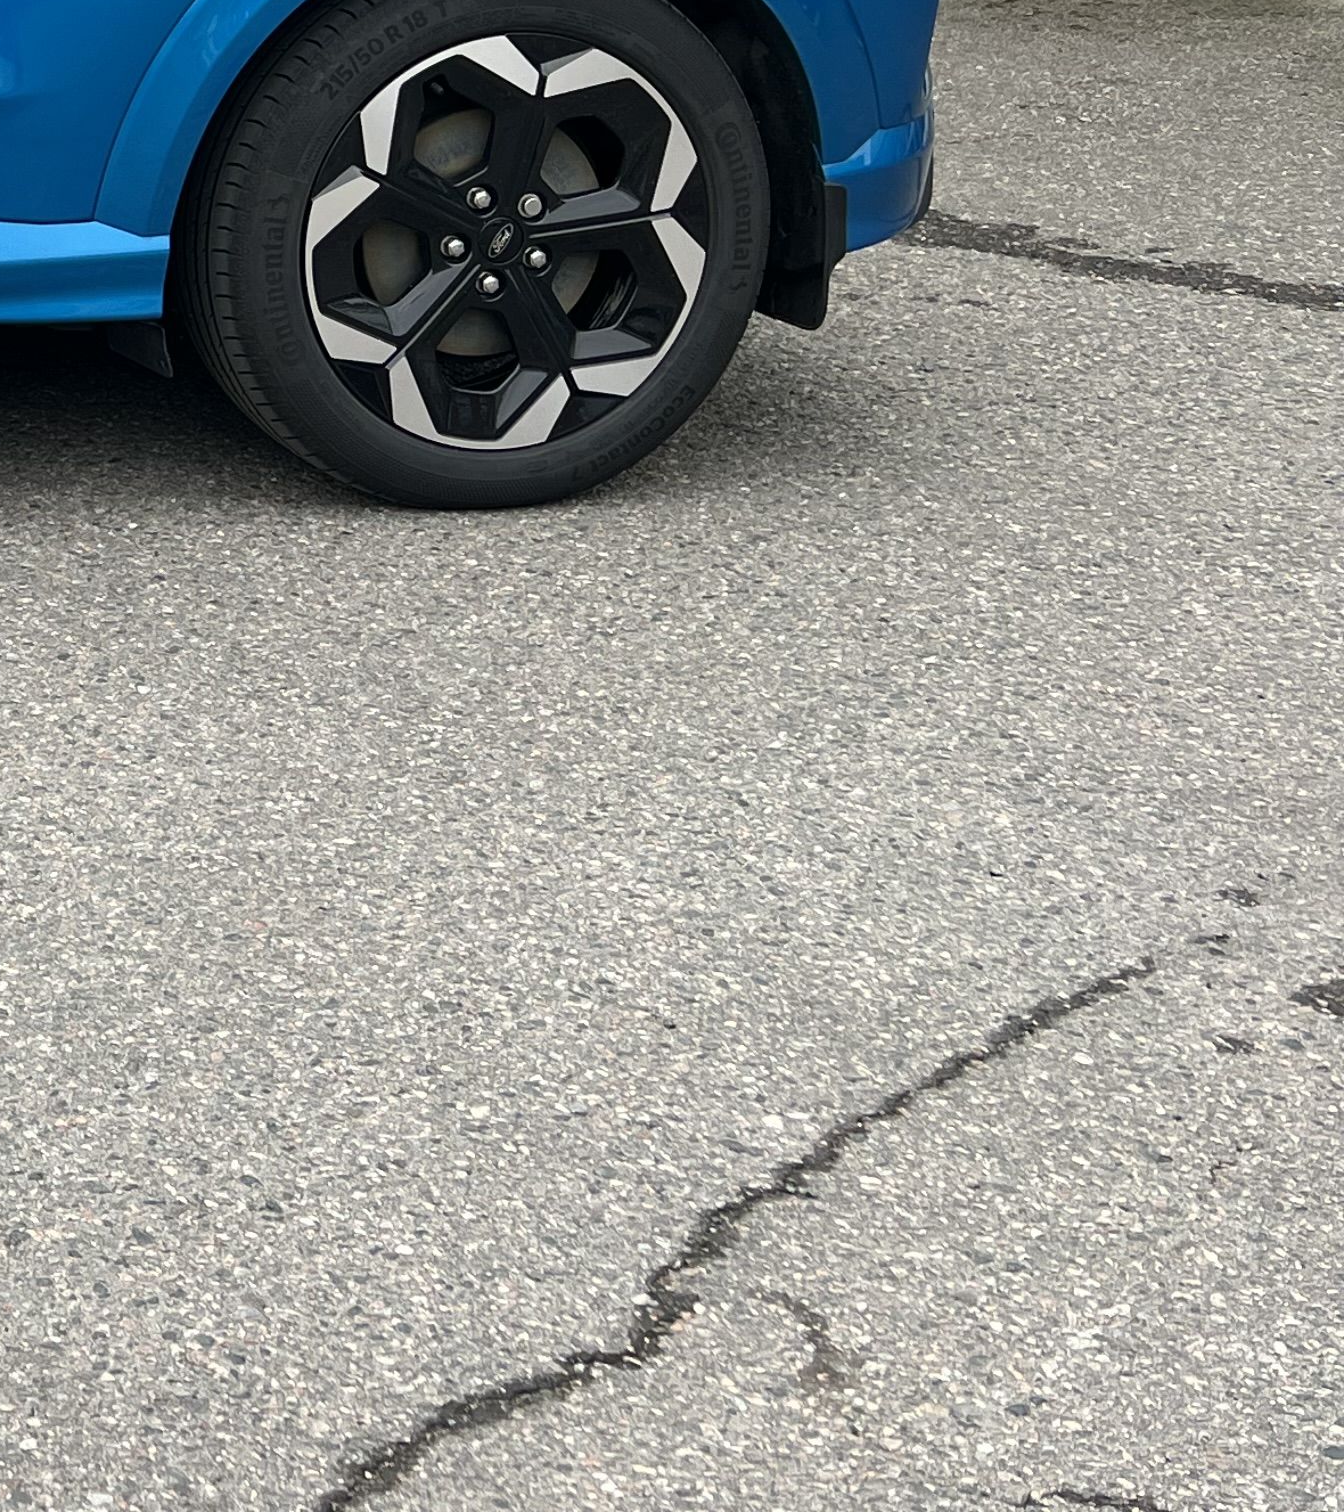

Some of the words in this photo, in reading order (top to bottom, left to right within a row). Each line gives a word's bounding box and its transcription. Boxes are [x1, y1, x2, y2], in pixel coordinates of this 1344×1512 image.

[319, 38, 385, 101] 215/50
[383, 24, 404, 44] R
[402, 9, 429, 33] 18
[715, 121, 754, 272] Continental
[262, 215, 307, 367] Continental
